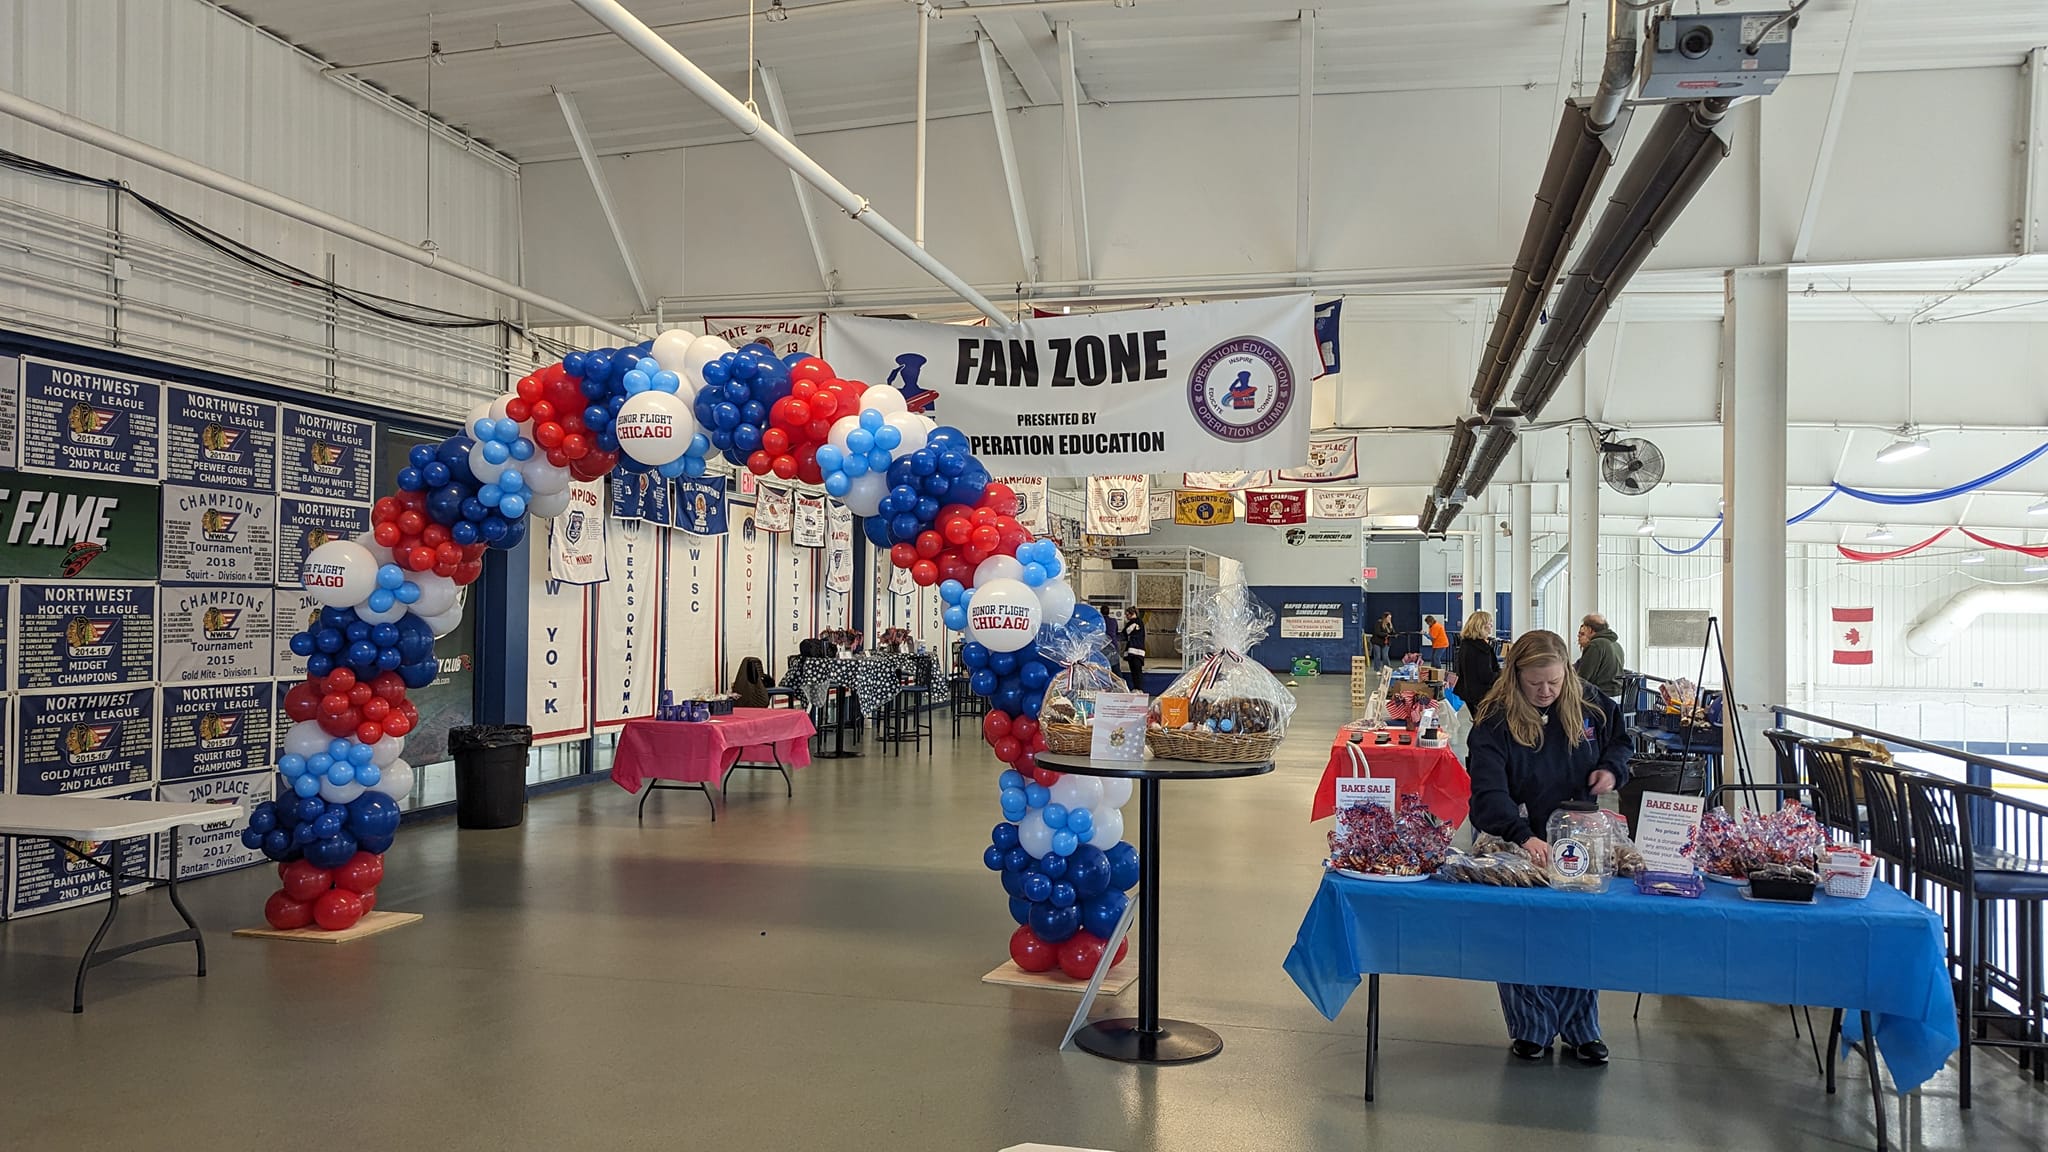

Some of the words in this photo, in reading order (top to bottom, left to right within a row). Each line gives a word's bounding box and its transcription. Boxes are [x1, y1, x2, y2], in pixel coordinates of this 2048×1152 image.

[778, 322, 814, 337] PLACE
[787, 342, 798, 353] 13
[955, 338, 1039, 388] FAN
[1049, 330, 1168, 388] ZONE
[1229, 356, 1253, 365] INSPIRE
[1194, 344, 1239, 392] OPERATION
[1242, 342, 1289, 388] EDUCATION
[52, 370, 140, 396] NORTHWEST
[44, 386, 93, 402] HOCKEY
[101, 395, 145, 410] LEAGUE
[188, 394, 259, 416] NORTHWEST
[1209, 387, 1224, 415] EDUCATE
[1257, 384, 1273, 413] CONNECT
[182, 408, 222, 422] HOCKEY
[230, 416, 265, 428] LEAGUE
[299, 414, 358, 435] NORTHWEST
[640, 414, 672, 424] FLIGHT
[1017, 412, 1079, 427] PRESENTED
[1082, 412, 1096, 425] BY
[1198, 406, 1255, 437] OPERATION
[1257, 401, 1285, 431] CLIMB
[77, 434, 108, 445] 2017-18
[295, 426, 326, 440] HOCKEY
[332, 434, 364, 446] LEAGUE
[618, 426, 672, 440] CHICAGO
[967, 434, 1055, 455] PERATION
[1060, 431, 1165, 455] EDUCATION
[1325, 444, 1348, 452] PLACE
[62, 446, 100, 458] SQUIRT
[104, 450, 127, 462] BLUE
[68, 459, 90, 470] 2ND
[92, 462, 120, 472] PLACE
[194, 461, 226, 472] PEEWEE
[228, 466, 253, 476] GREEN
[200, 474, 248, 486] CHAMPIONS
[302, 474, 330, 486] BANTAM
[331, 478, 353, 488] WHITE
[310, 486, 326, 495] 2ND
[326, 488, 346, 498] PLACE
[1270, 494, 1300, 502] CHAMPIONS
[180, 494, 262, 519] CHAMPIONS
[1178, 496, 1218, 505] PRESIDENTS
[298, 502, 356, 519] NORTHWEST
[7, 490, 118, 546] FAME
[292, 515, 326, 526] HOCKEY
[330, 518, 360, 530] LEAGUE
[189, 541, 252, 554] Tournament
[206, 557, 236, 568] 2018
[186, 570, 208, 580] Squirt
[218, 570, 247, 580] Division
[313, 564, 346, 576] FLIGHT
[626, 544, 634, 606] TEXAS
[45, 588, 133, 602] NORTHWEST
[180, 592, 264, 612] CHAMPIONS
[38, 605, 86, 614] HOCKEY
[95, 605, 138, 614] LEAGUE
[972, 605, 996, 617] HONOR
[998, 605, 1030, 617] FLIGHT
[972, 616, 1030, 630] CHICAGO
[75, 647, 106, 656] 2014-15
[191, 640, 254, 652] Tournament
[69, 660, 108, 670] MIDGET
[206, 656, 235, 666] 2015
[444, 656, 462, 672] CLUB
[58, 672, 118, 684] CHAMPIONS
[182, 669, 198, 680] Gold
[200, 668, 216, 679] Mite
[224, 666, 252, 678] Division
[253, 667, 258, 676] 1
[183, 686, 255, 700] NORTHWEST
[46, 693, 134, 710] NORTHWEST
[176, 702, 217, 712] HOCKEY
[224, 699, 260, 710] LEAGUE
[37, 712, 86, 724] HOCKEY
[94, 708, 140, 720] LEAGUE
[76, 752, 106, 762] 2015-16
[194, 752, 224, 762] SQUIRT
[225, 749, 242, 760] RED
[41, 769, 70, 780] GOLD
[73, 766, 97, 777] MITE
[100, 761, 131, 772] WHITE
[194, 760, 242, 774] CHAMPIONS
[60, 781, 80, 792] 2ND
[84, 776, 114, 788] PLACE
[1342, 784, 1366, 792] BAKE
[1368, 785, 1390, 793] SALE
[189, 784, 212, 802] 2ND
[216, 781, 249, 794] PLACE
[1646, 800, 1672, 810] BAKE
[1673, 802, 1698, 812] SALE
[203, 844, 232, 858] 2017
[181, 862, 210, 874] Bantam
[216, 856, 245, 868] Division
[54, 870, 96, 888] BANTAM
[60, 888, 80, 900] 2ND
[82, 880, 112, 894] PLACE
